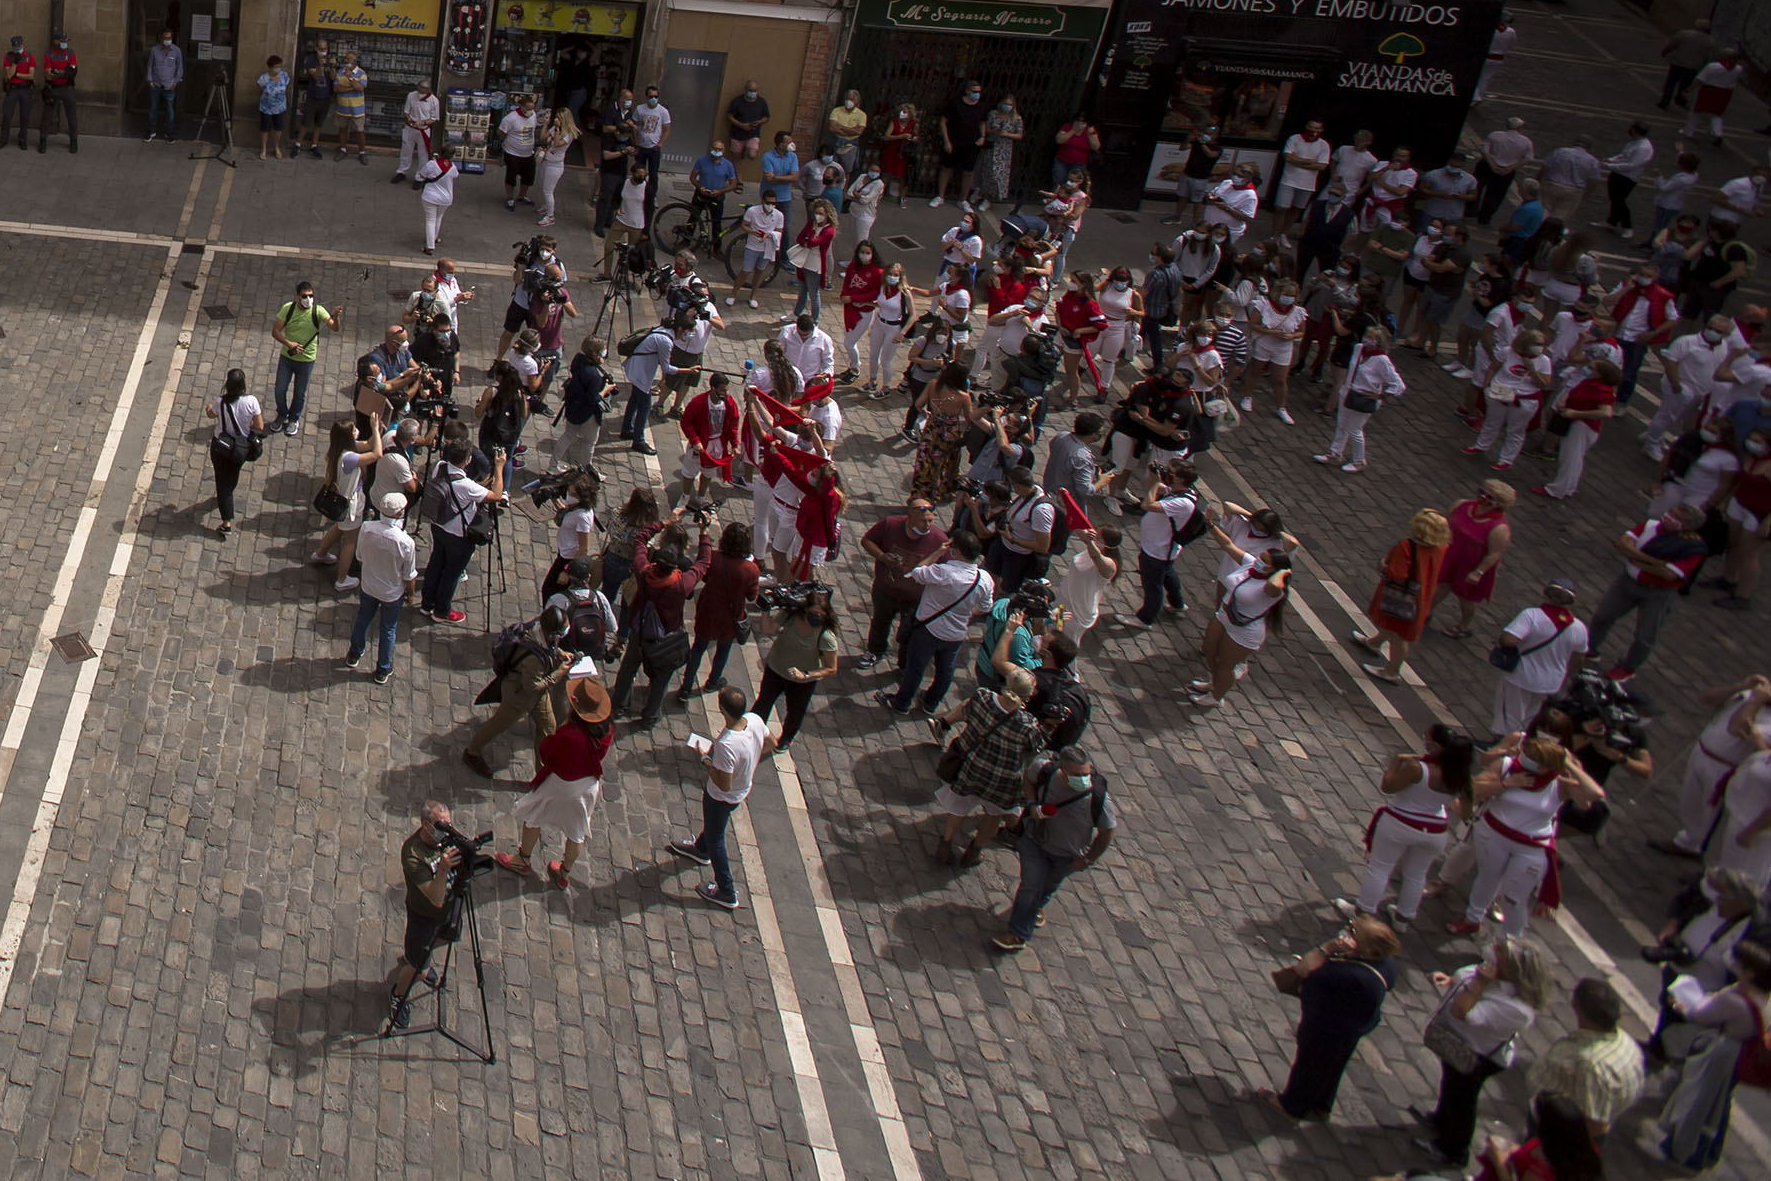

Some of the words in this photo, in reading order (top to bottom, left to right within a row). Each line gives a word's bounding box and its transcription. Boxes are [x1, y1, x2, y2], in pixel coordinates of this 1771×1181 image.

[318, 9, 375, 26] Helados
[379, 14, 428, 30] Lilian
[931, 6, 991, 22] Sagrario
[993, 11, 1053, 26] Navarro
[1337, 73, 1457, 97] SALAMANCA
